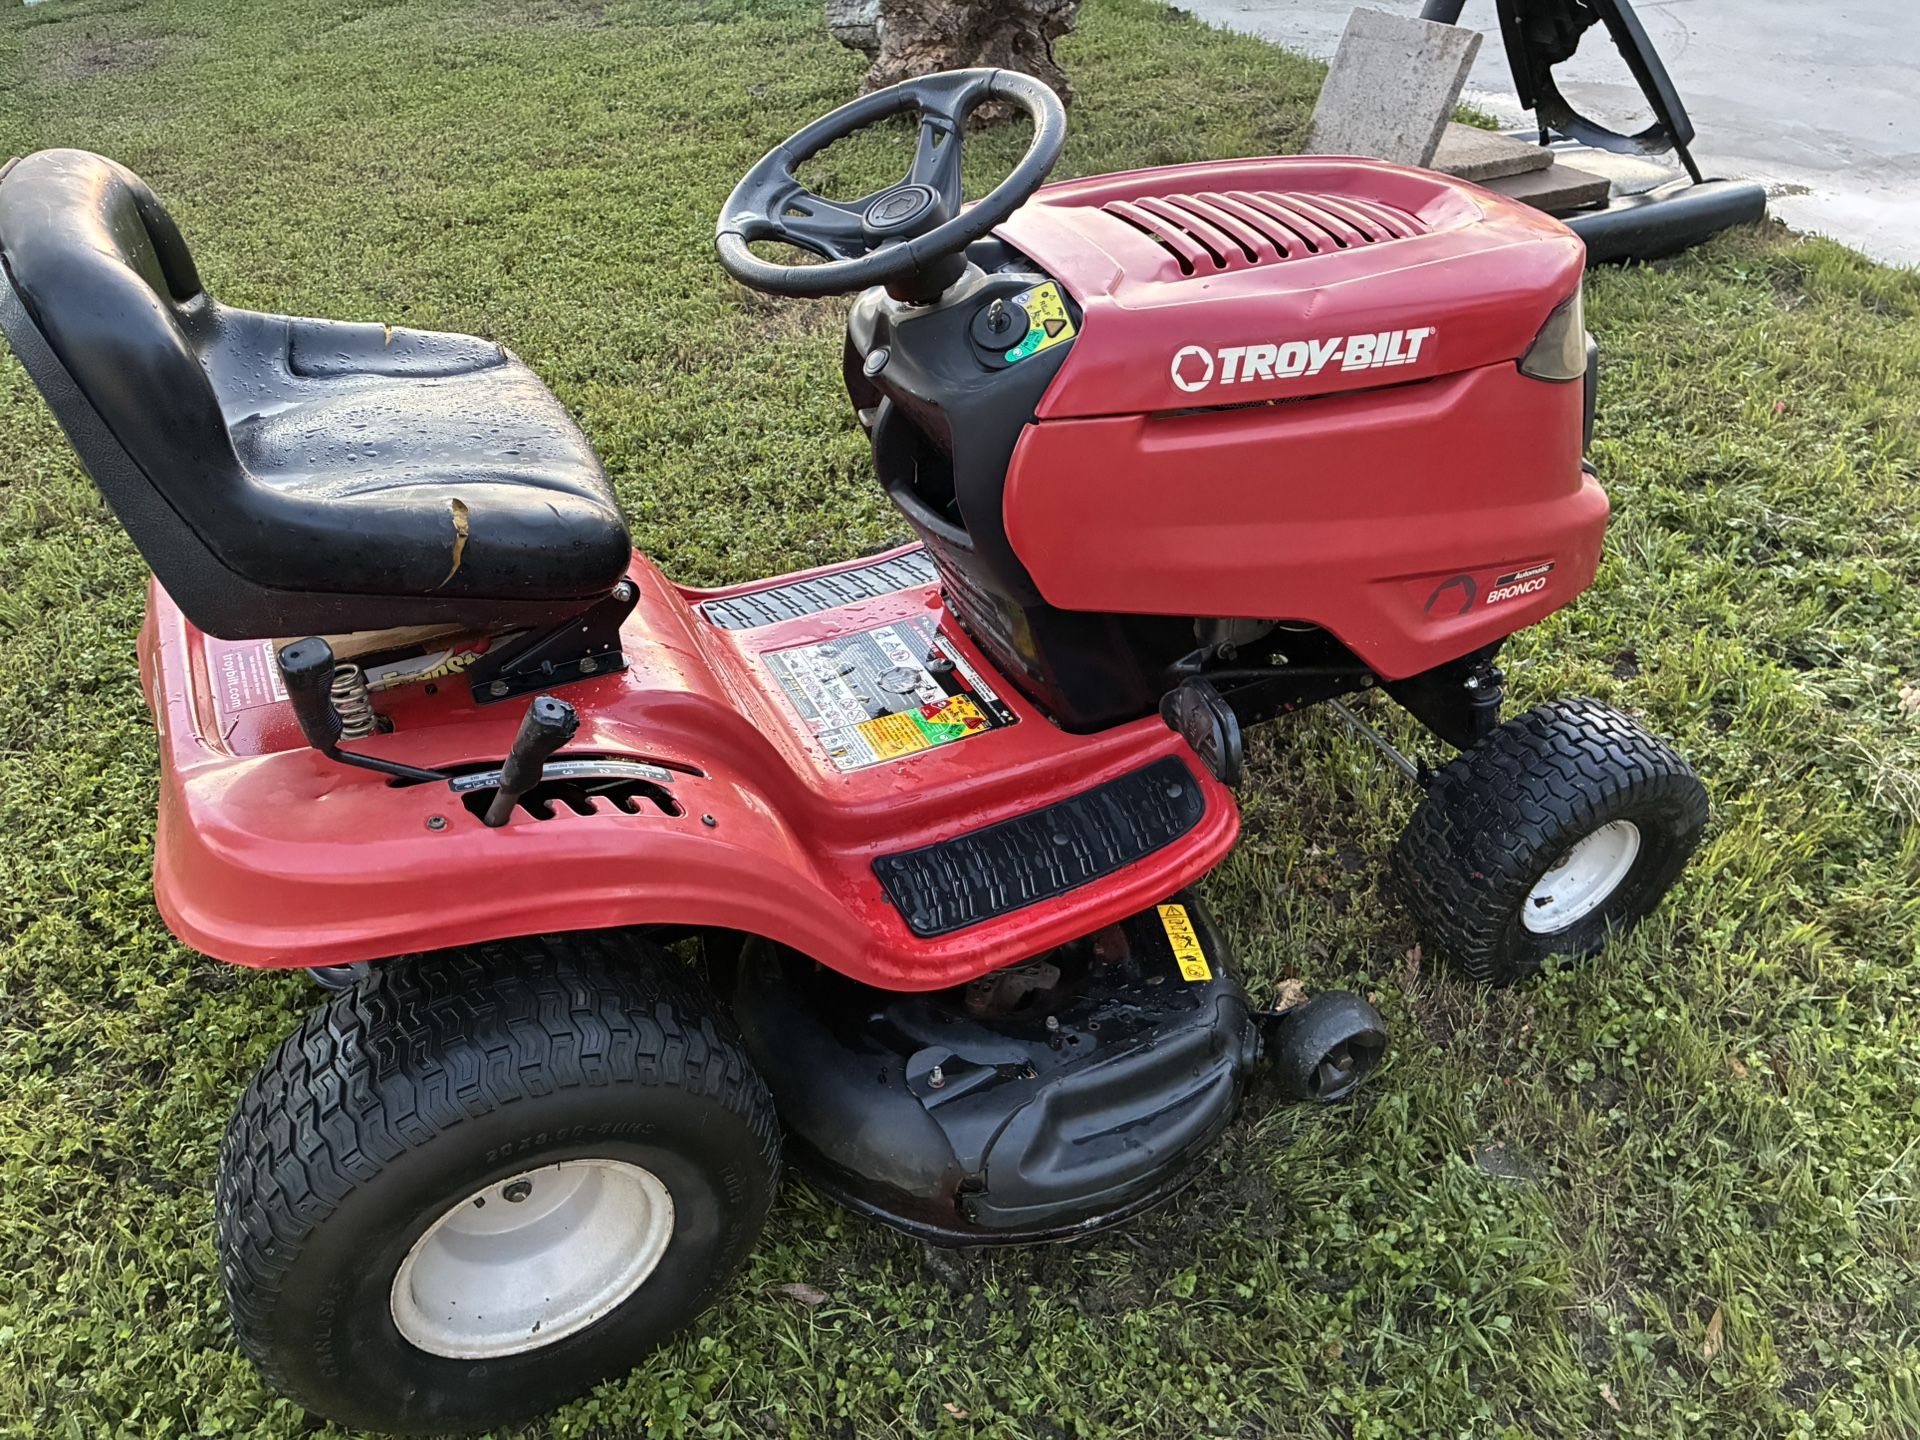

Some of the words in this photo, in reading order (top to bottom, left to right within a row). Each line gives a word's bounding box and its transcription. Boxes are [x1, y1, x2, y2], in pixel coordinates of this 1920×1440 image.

[1217, 327, 1431, 384] TROY-BILT
[1486, 577, 1546, 604] BRONCO
[1514, 564, 1550, 580] Automatic
[221, 653, 242, 708] troybilt.com
